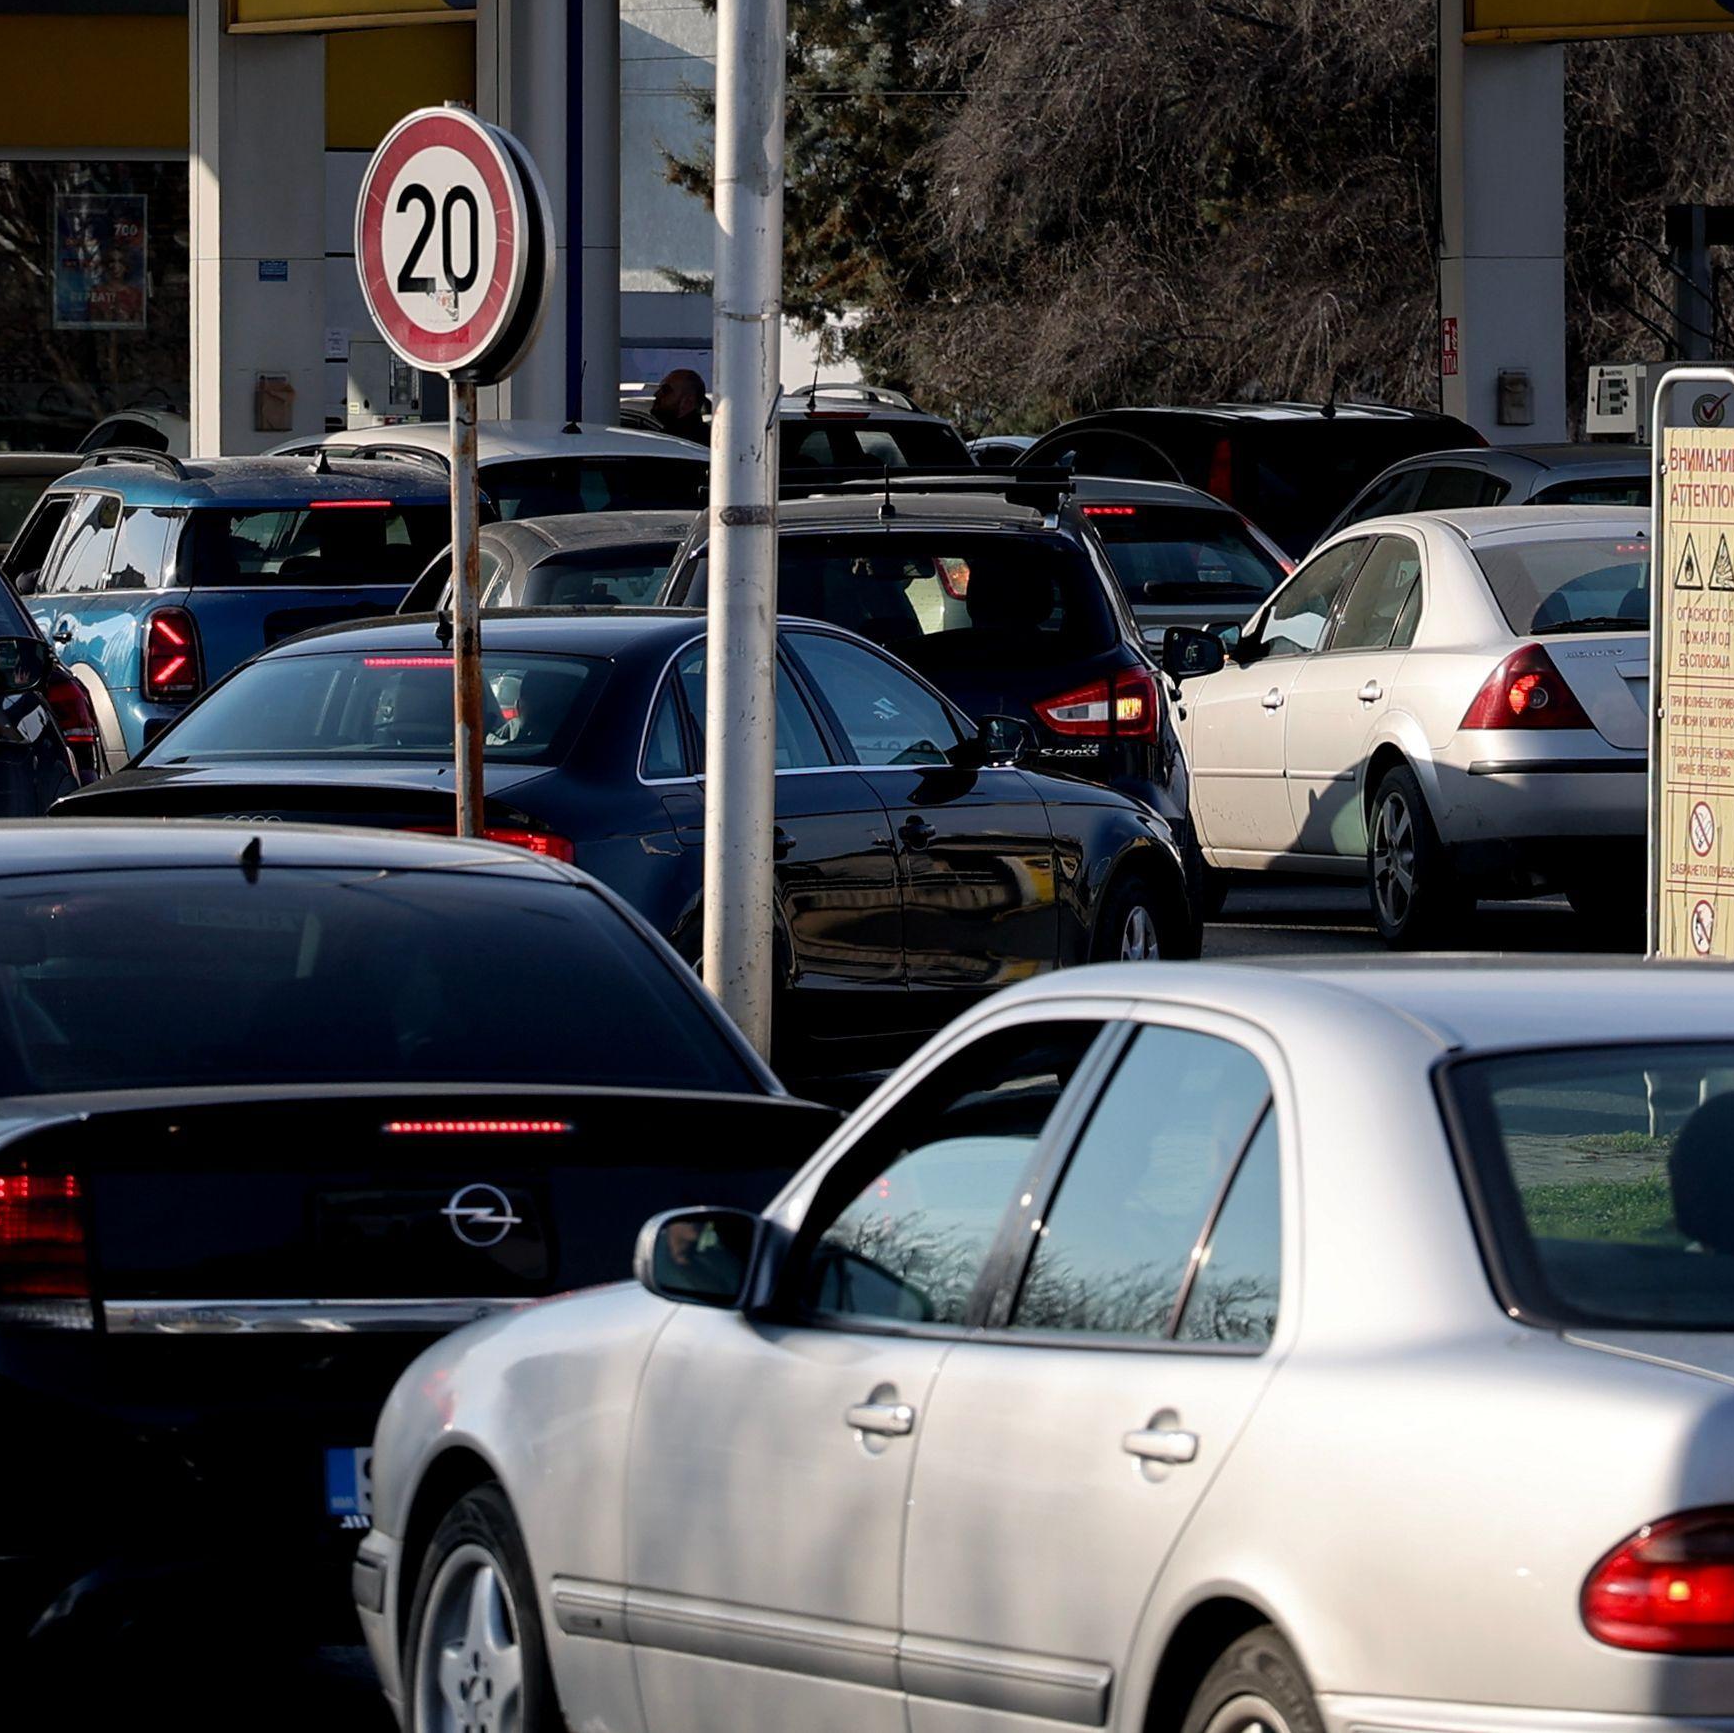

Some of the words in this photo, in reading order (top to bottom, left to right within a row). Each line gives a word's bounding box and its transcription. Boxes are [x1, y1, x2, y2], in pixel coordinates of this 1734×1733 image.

[396, 183, 480, 294] 20
[1677, 607, 1721, 624] ОПАСНОСТ
[1722, 609, 1734, 625] ОД
[1680, 630, 1710, 646] ПОЖАР
[1719, 631, 1730, 648] ОД
[1679, 653, 1731, 670] ЕКСПЛОЗИЈА
